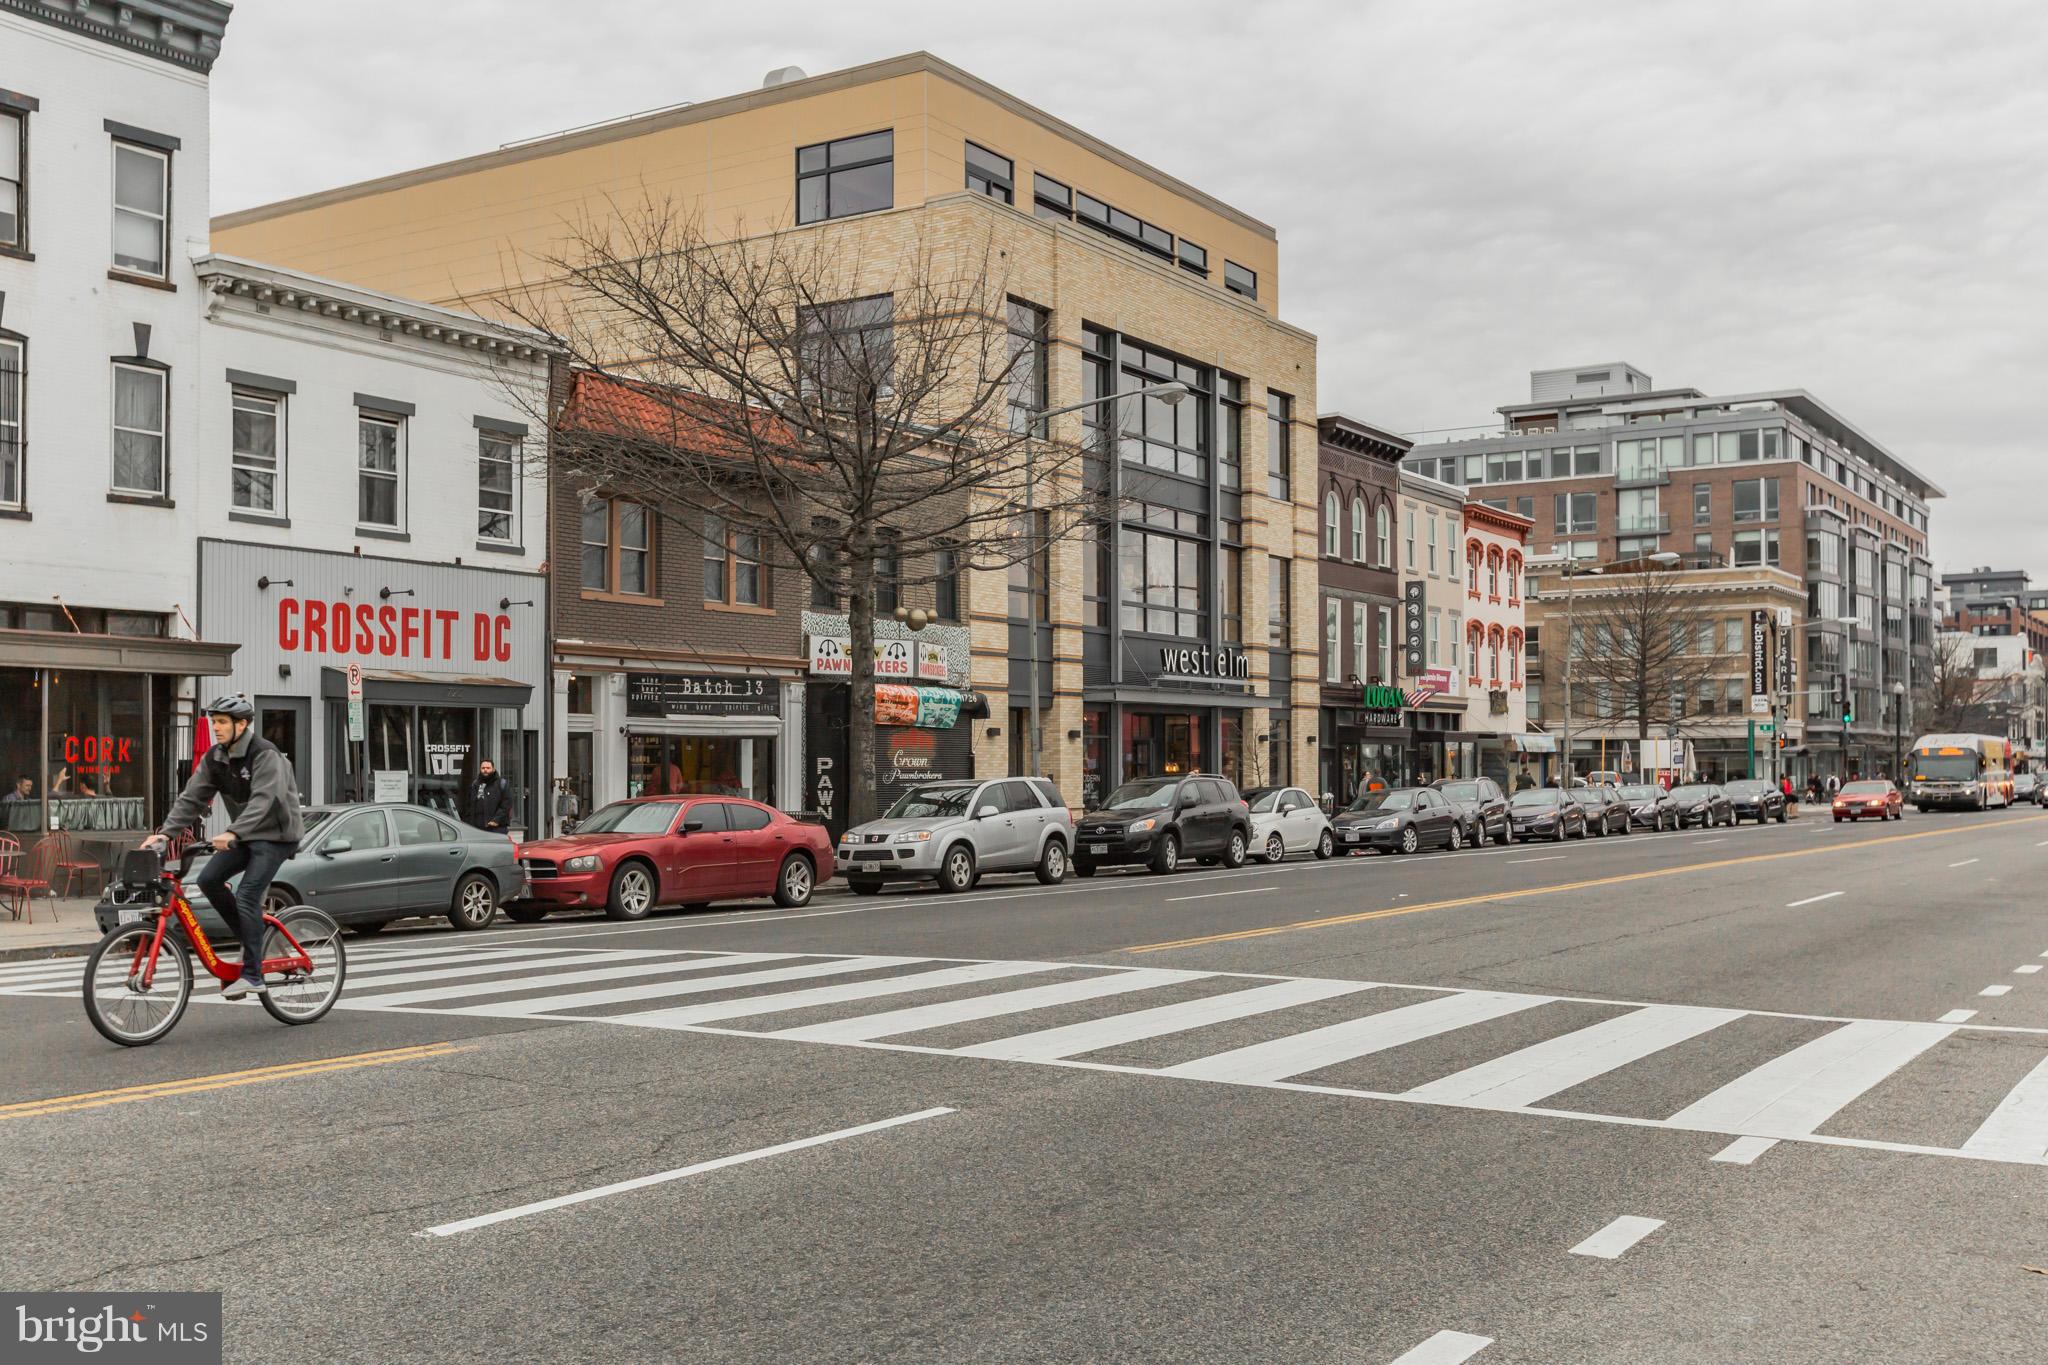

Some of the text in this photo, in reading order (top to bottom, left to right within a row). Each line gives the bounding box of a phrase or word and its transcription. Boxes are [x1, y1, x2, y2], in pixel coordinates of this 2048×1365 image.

[279, 598, 511, 662] CROSSFIT DC
[816, 658, 908, 673] PAWNKERS
[1163, 645, 1249, 678] west elm
[682, 678, 764, 695] Batch 13
[631, 693, 659, 701] spirits
[1364, 686, 1403, 707] LOGAN
[1365, 713, 1398, 724] HARDWARE
[65, 736, 130, 763] CORK
[425, 744, 470, 753] CROSSFIT
[431, 753, 464, 775] DC
[893, 749, 928, 767] Crown
[883, 768, 942, 784] Pawnbrokers
[817, 757, 834, 820] PAWN
